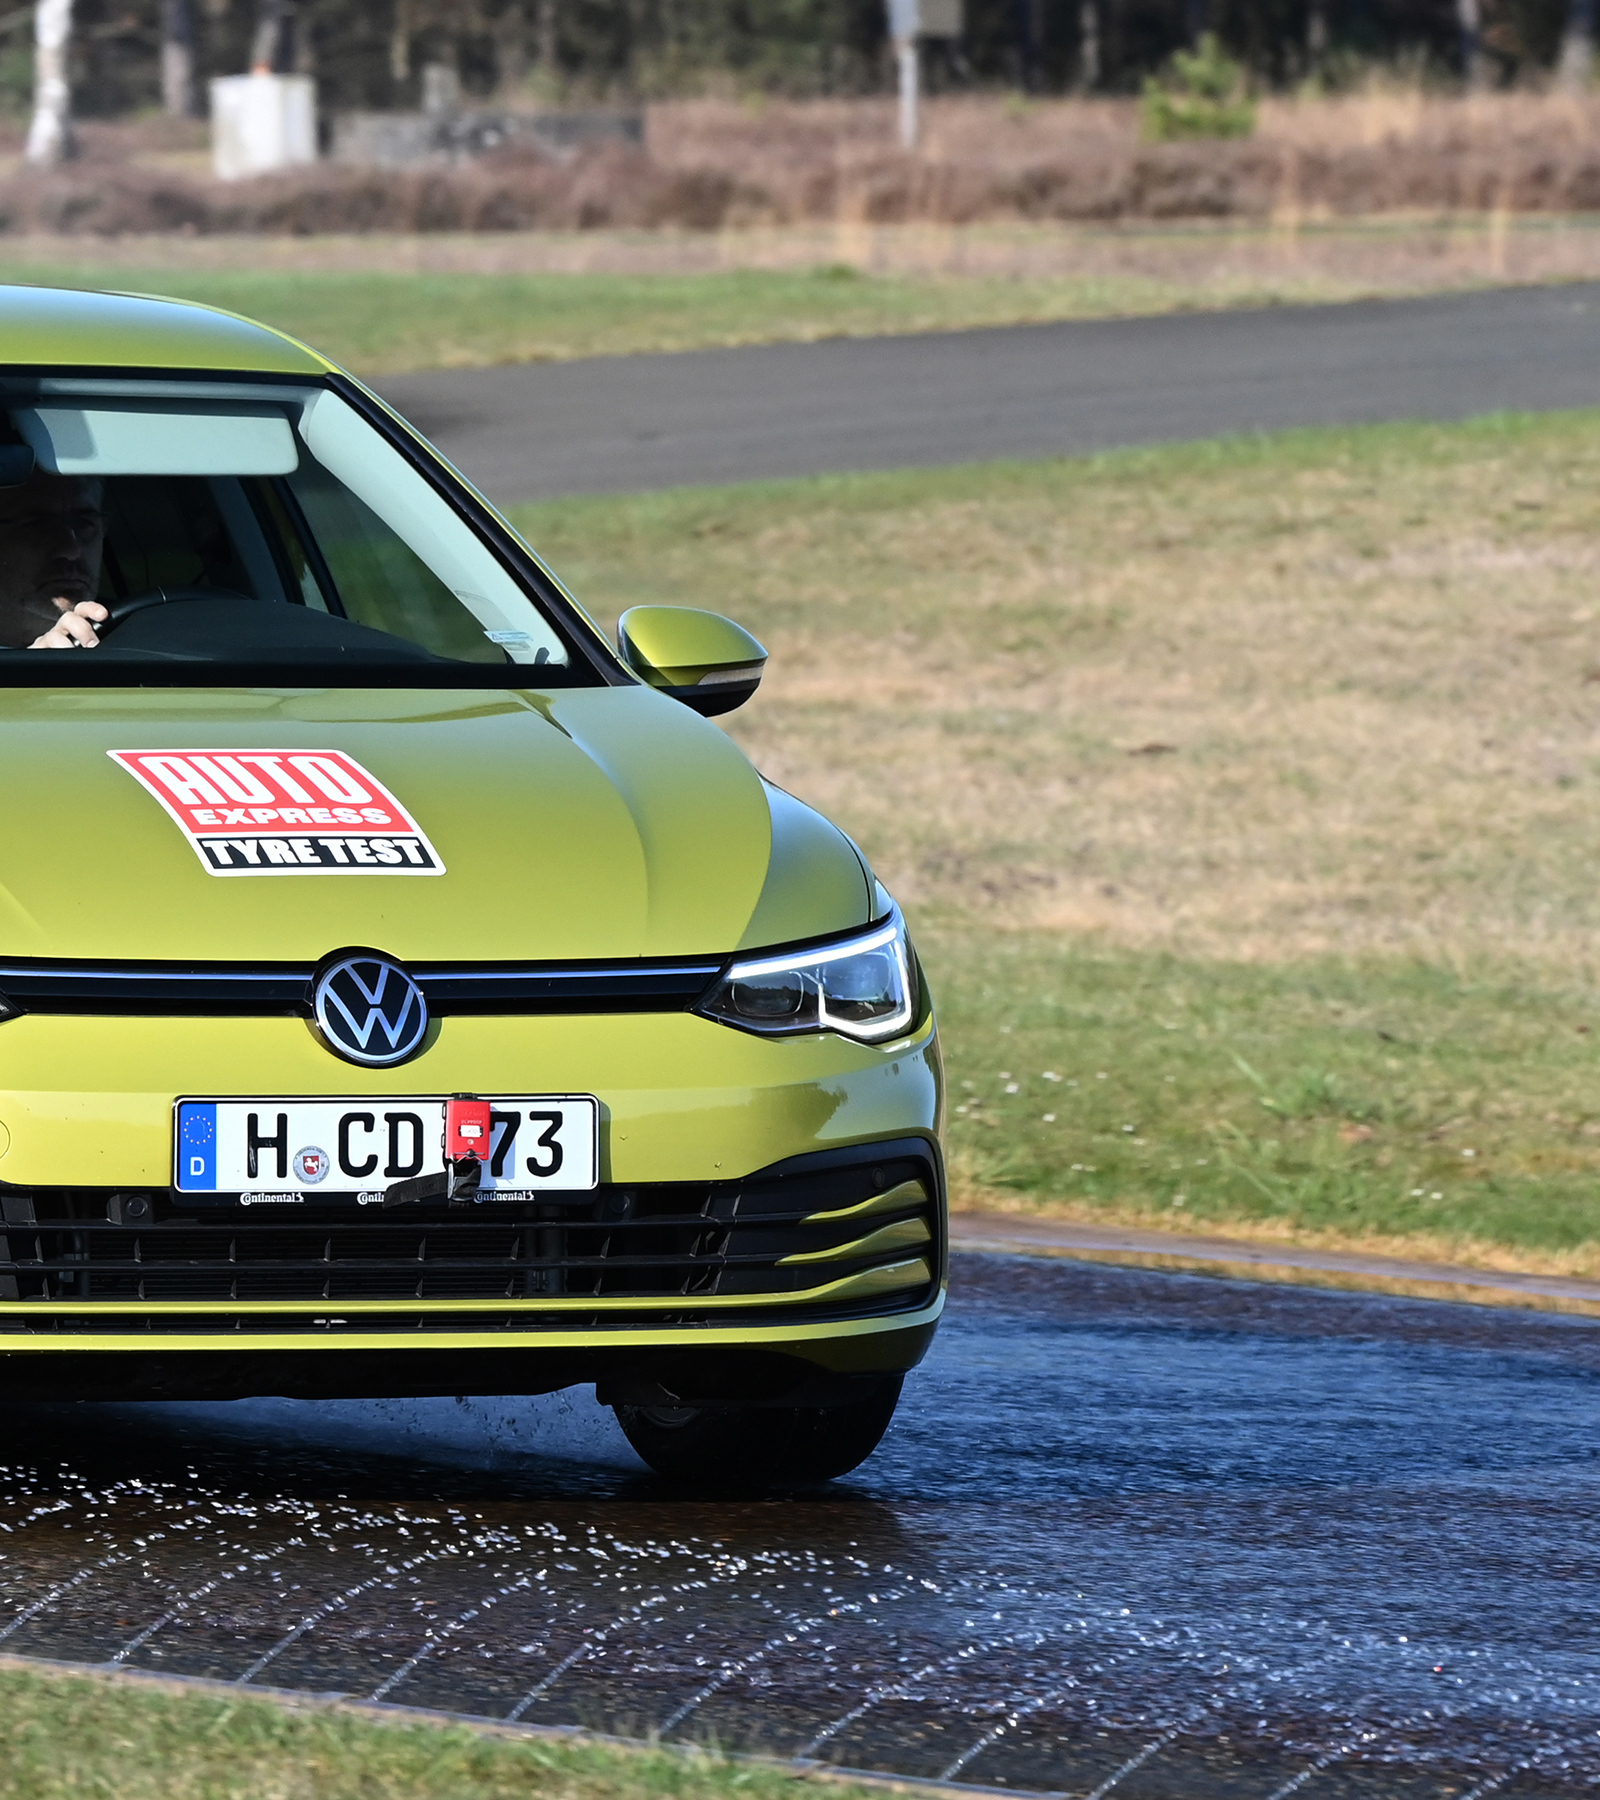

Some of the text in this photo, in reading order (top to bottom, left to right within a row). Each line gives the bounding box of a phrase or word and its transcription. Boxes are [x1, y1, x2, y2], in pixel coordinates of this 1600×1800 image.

[137, 756, 373, 805] AUTO
[189, 807, 392, 826] EXPRESS
[201, 838, 425, 865] TYRE TEST
[247, 1112, 289, 1179] H
[338, 1111, 425, 1178] CD
[487, 1110, 565, 1177] 73
[190, 1156, 205, 1176] D
[240, 1192, 296, 1206] Continental
[474, 1190, 526, 1204] Continental
